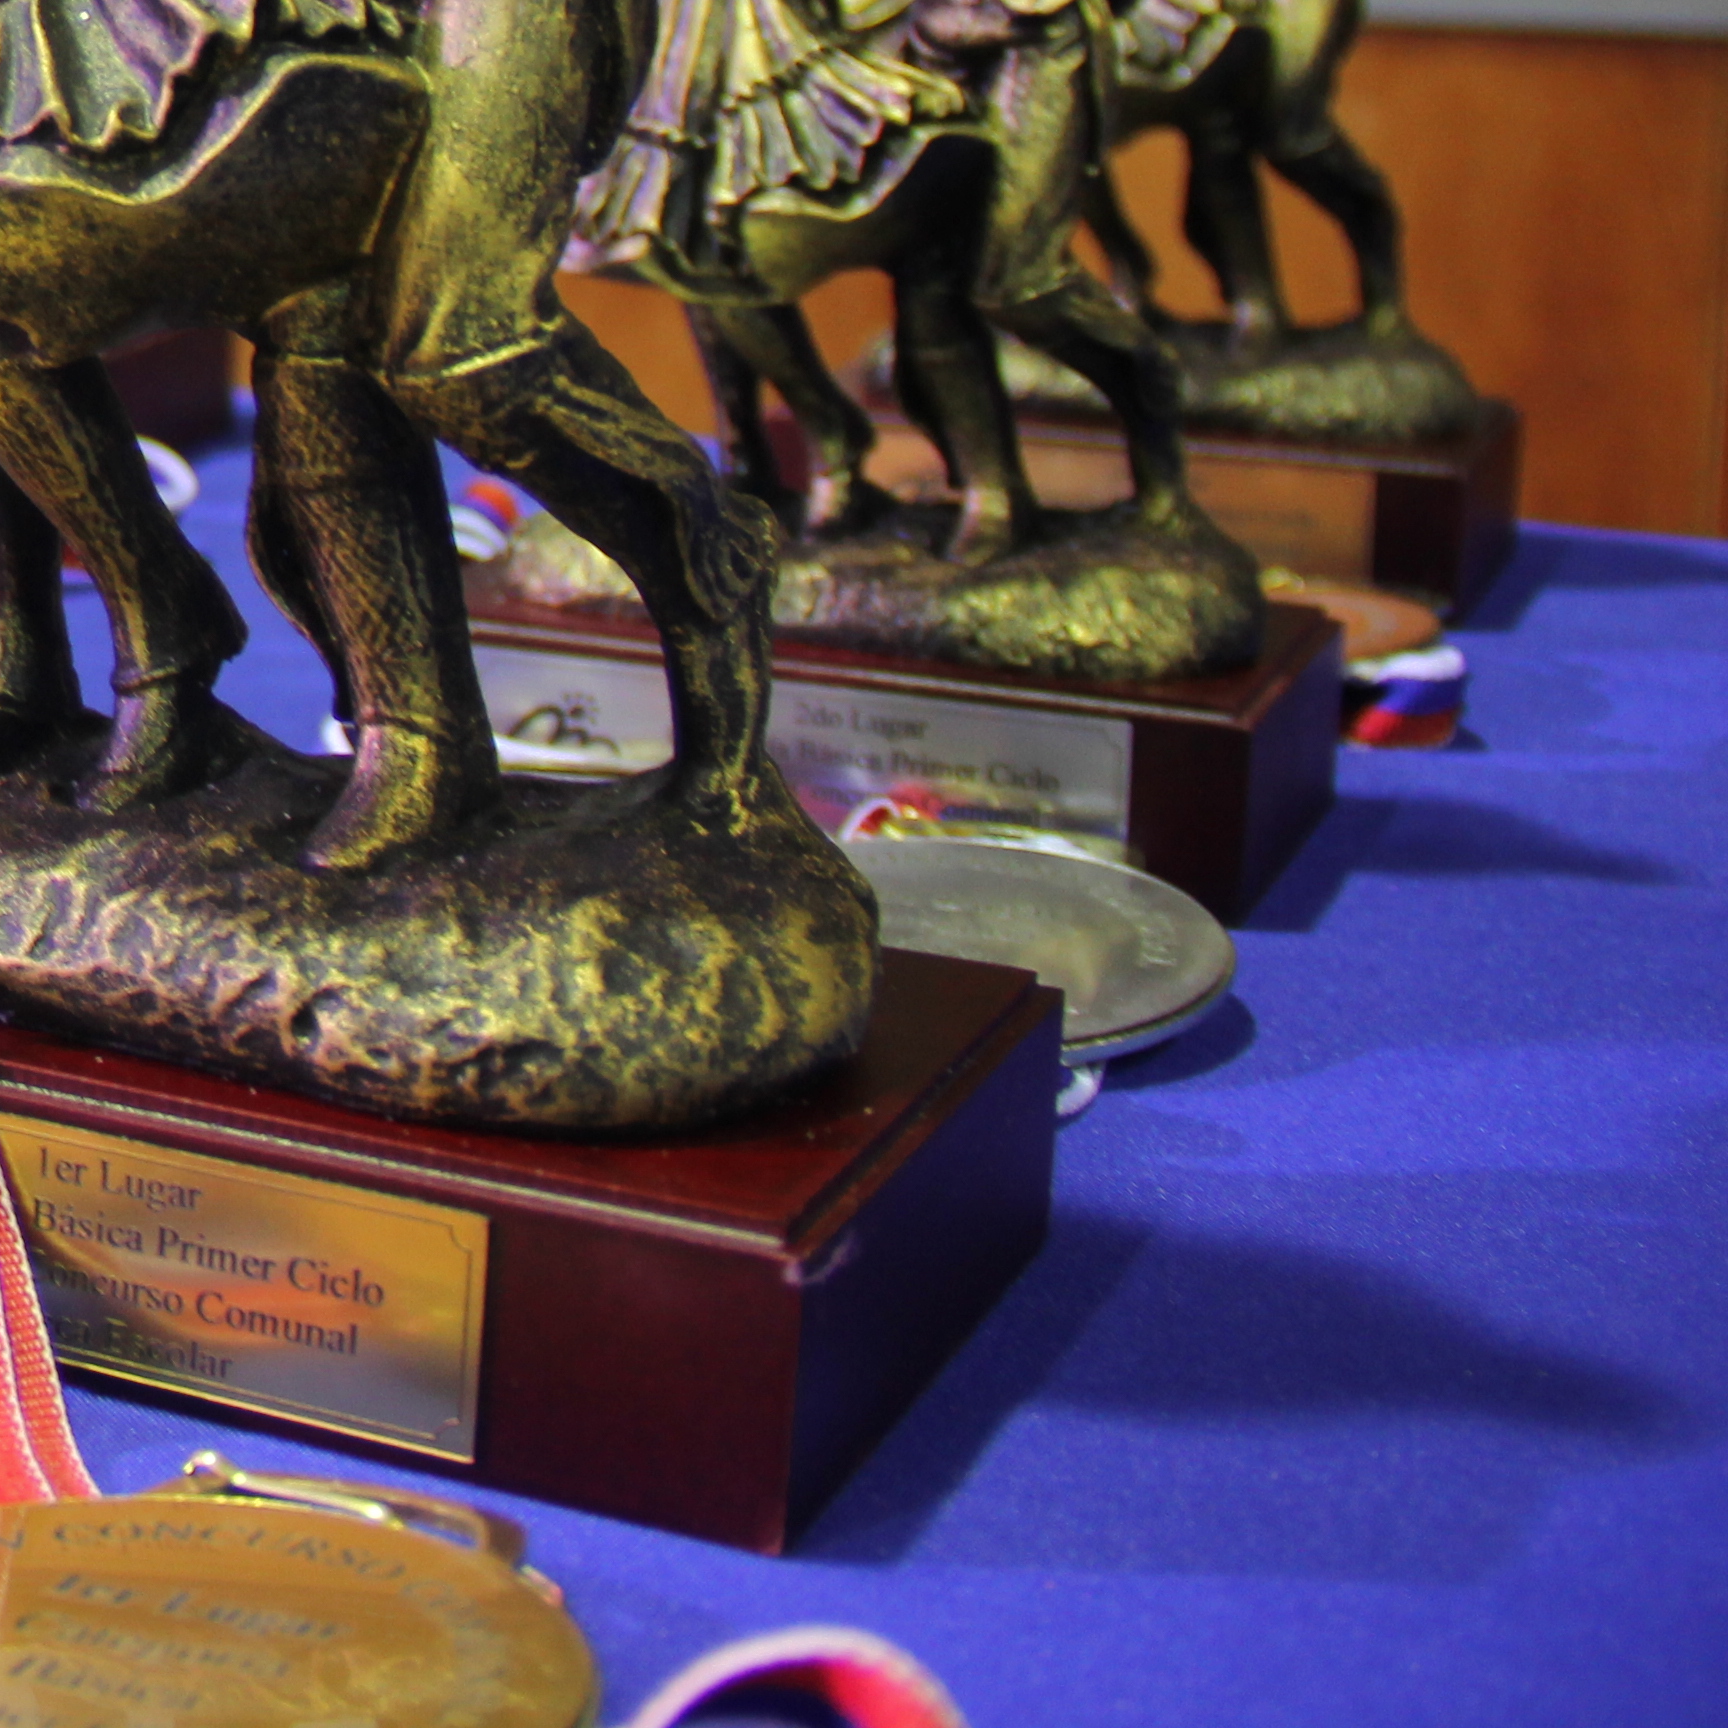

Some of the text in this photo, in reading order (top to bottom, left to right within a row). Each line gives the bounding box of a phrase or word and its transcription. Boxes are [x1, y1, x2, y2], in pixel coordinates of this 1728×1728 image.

[40, 1146, 204, 1211] 1er Lugar
[32, 1196, 385, 1307] Básica Primer Ciclo
[104, 1316, 234, 1378] Escolar
[195, 1290, 359, 1356] Comunal
